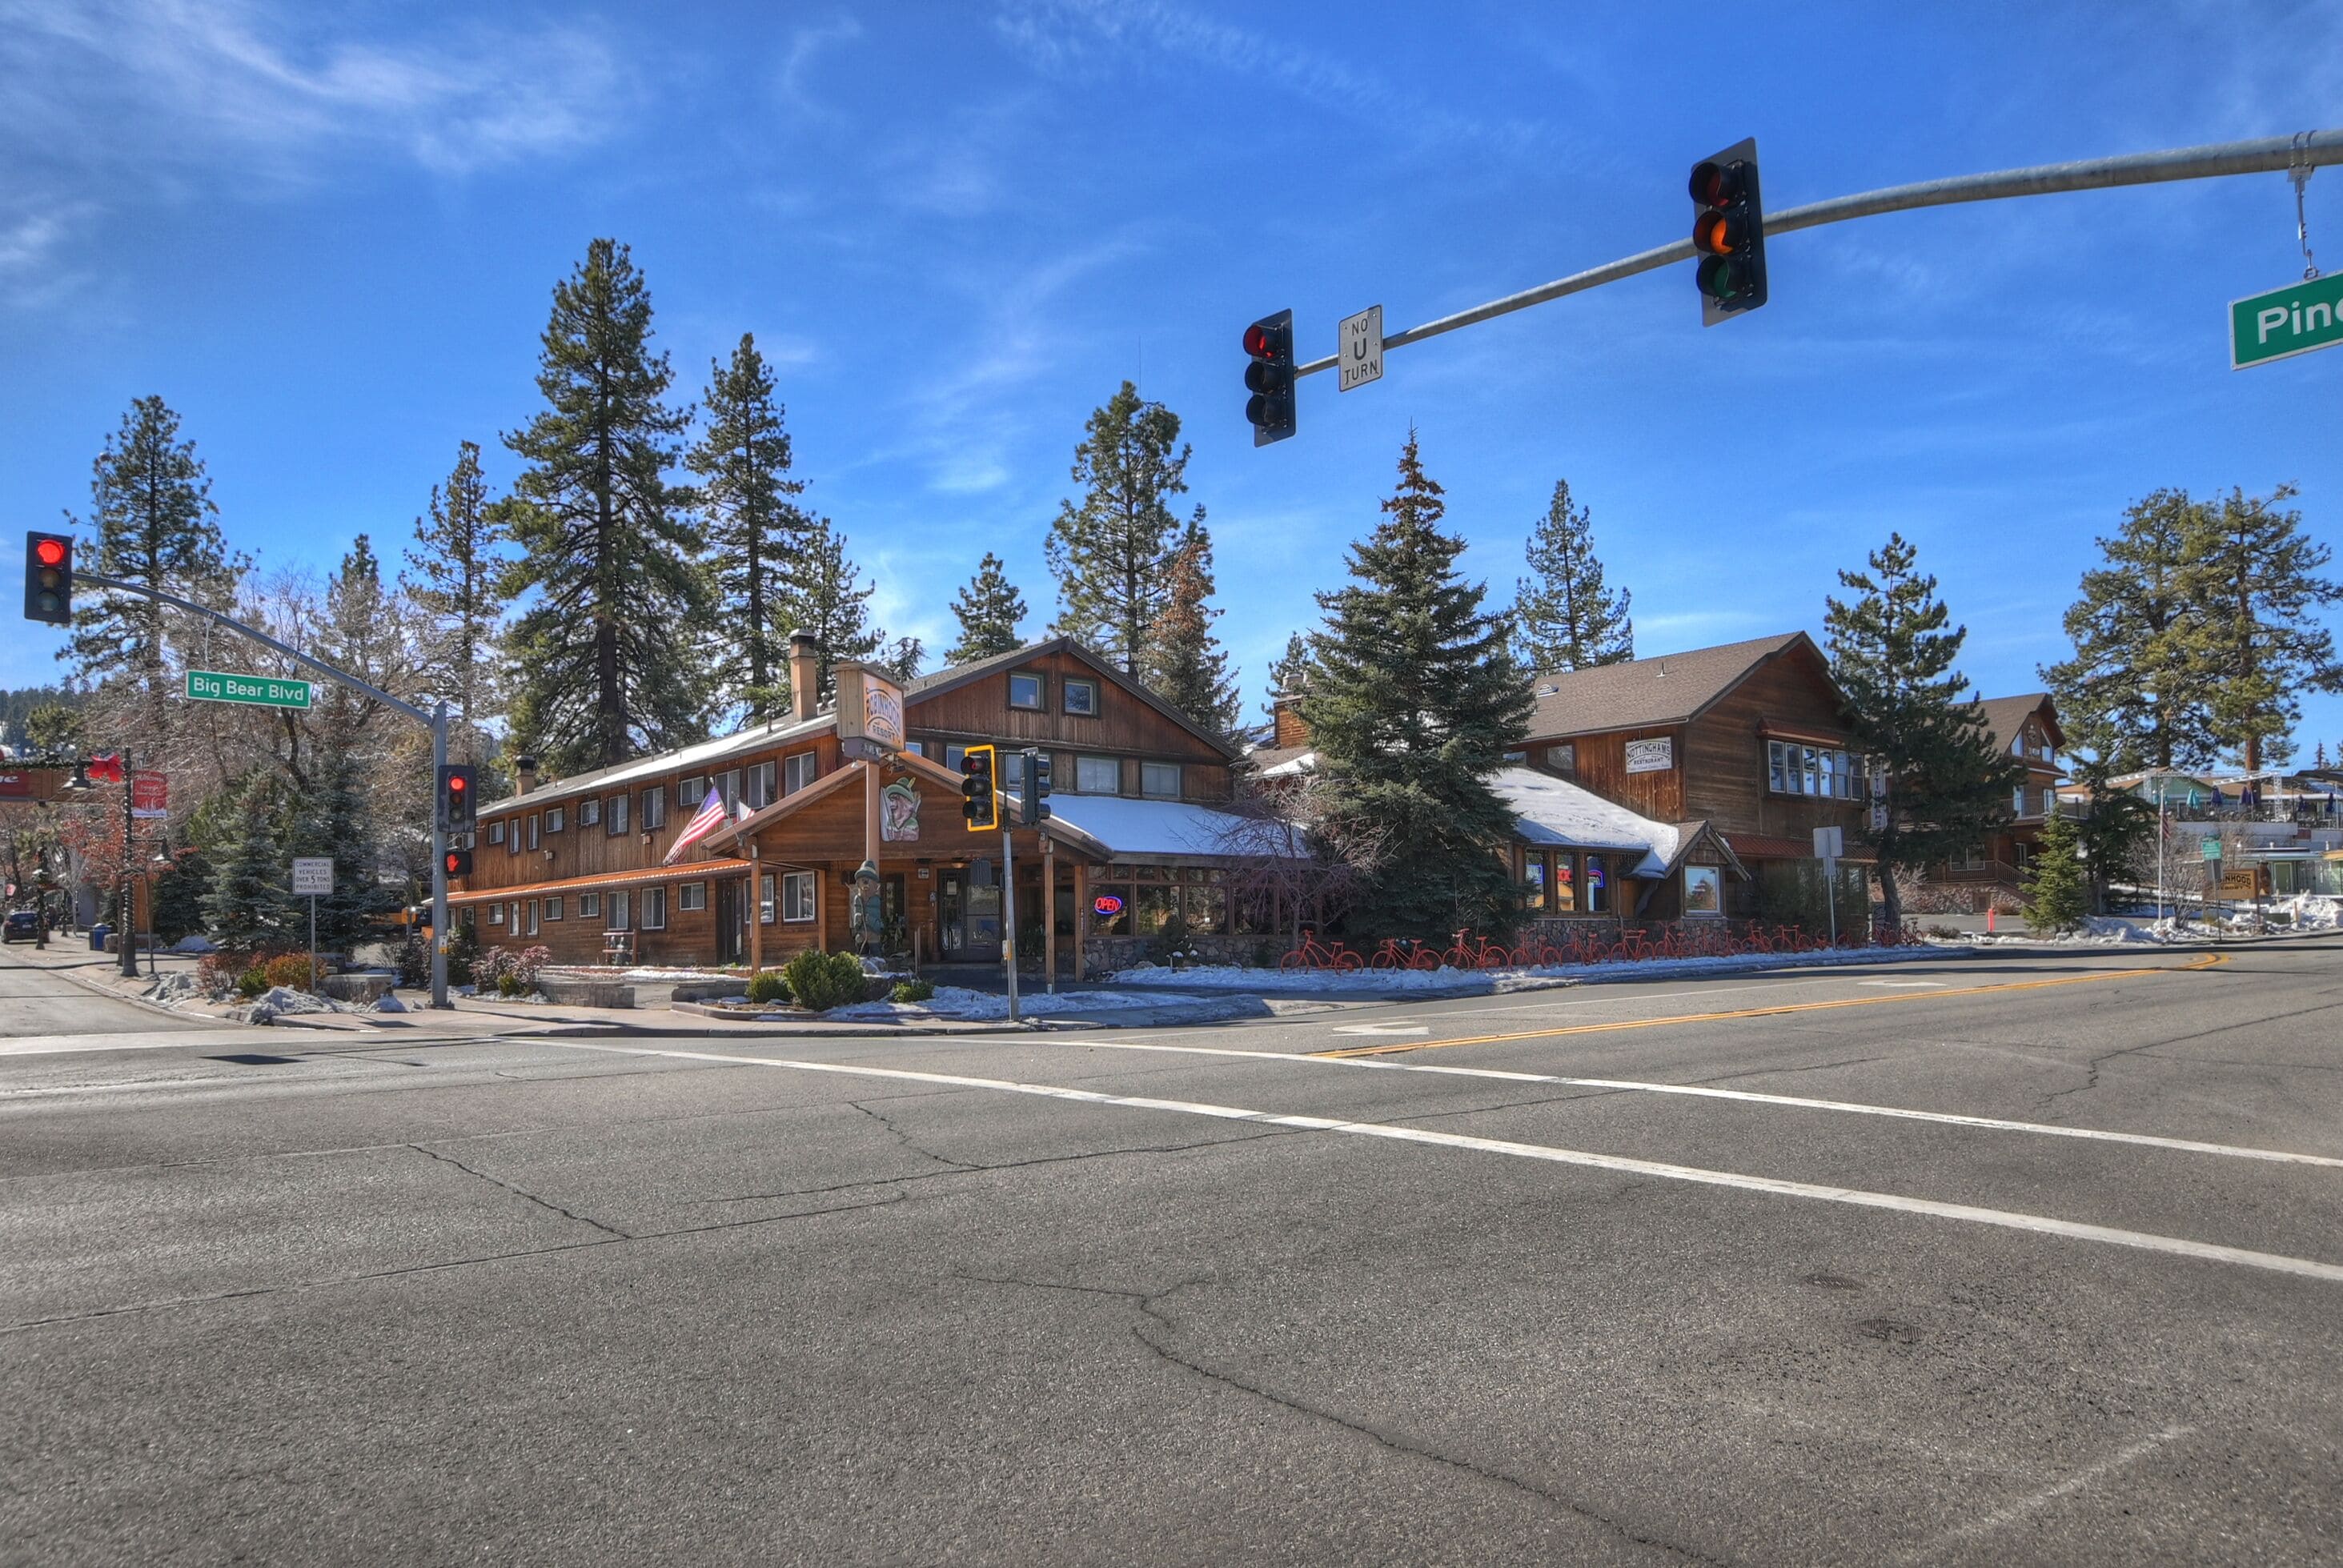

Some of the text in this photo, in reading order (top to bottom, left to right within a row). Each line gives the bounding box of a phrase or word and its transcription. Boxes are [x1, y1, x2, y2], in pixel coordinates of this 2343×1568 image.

[1351, 318, 1368, 336] NO
[1354, 338, 1367, 361] U
[1345, 359, 1378, 384] TURN
[194, 676, 303, 701] Big Bear Blvd
[866, 692, 901, 734] ROBINHOOD
[873, 724, 895, 741] RESORT
[1627, 742, 1671, 759] NOTTINGHAMS
[311, 875, 315, 884] 5
[1096, 897, 1119, 911] OPEN
